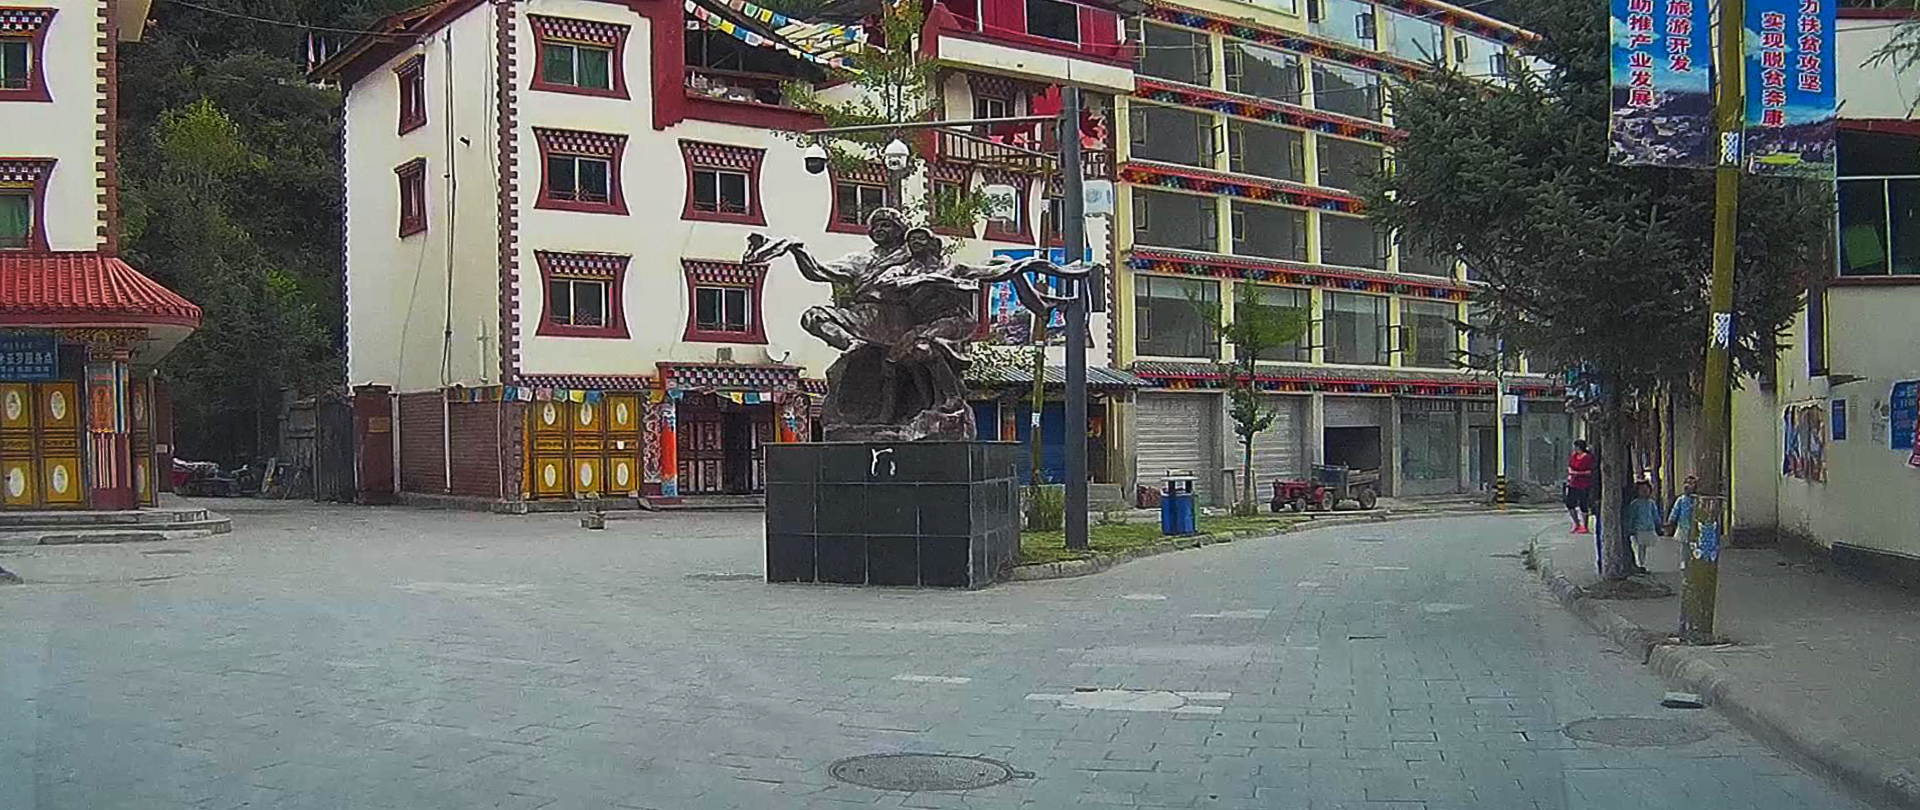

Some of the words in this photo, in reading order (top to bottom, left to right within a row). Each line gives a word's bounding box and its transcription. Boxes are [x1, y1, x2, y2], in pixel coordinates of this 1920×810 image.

[1761, 12, 1786, 128] 实现脱贫奔康
